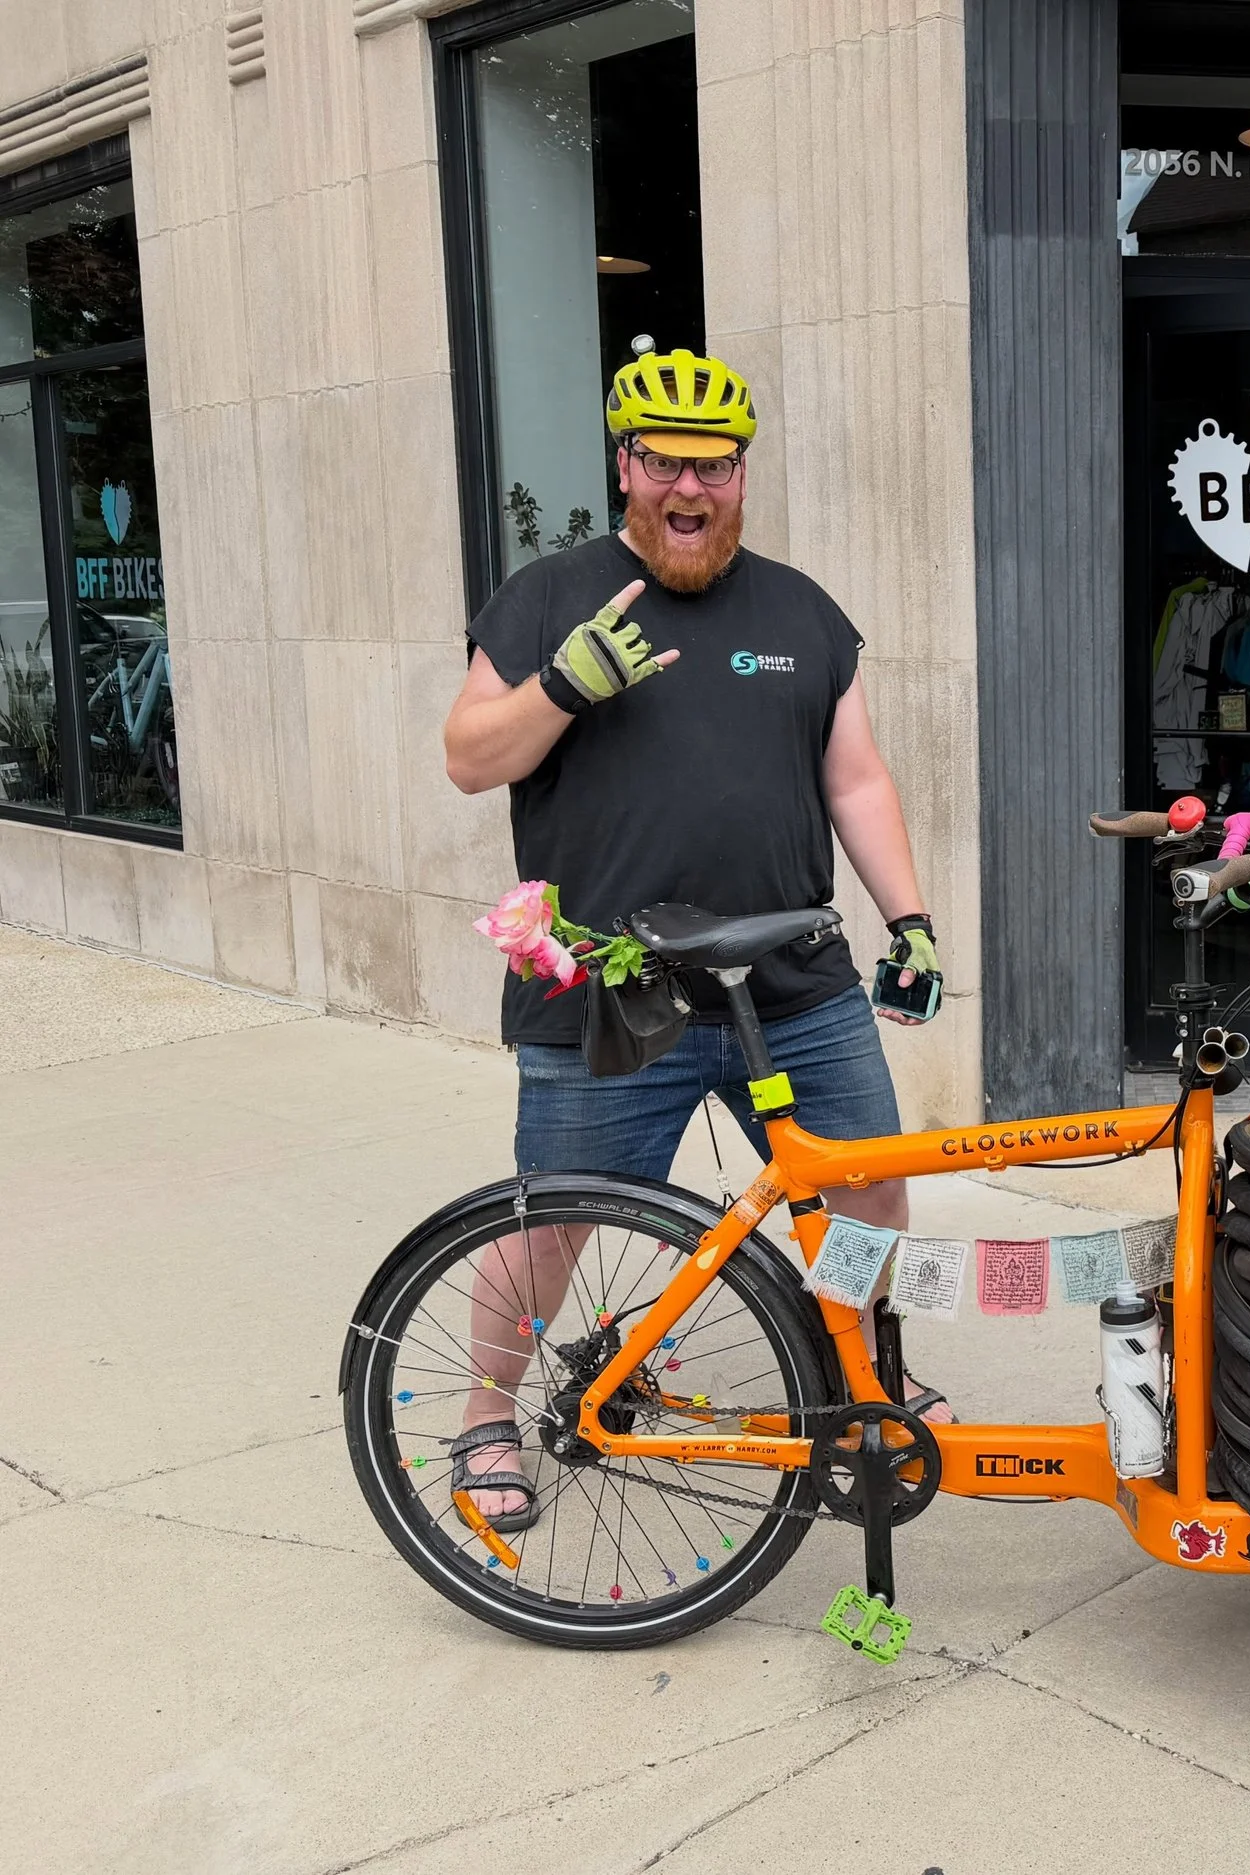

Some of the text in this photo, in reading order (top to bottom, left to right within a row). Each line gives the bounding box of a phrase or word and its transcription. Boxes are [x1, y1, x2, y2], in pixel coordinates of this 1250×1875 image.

[1125, 149, 1201, 177] 2056
[1209, 152, 1241, 178] N.
[75, 557, 108, 600] BFF
[757, 655, 795, 667] SHIFT
[759, 664, 795, 672] TRANSIT
[941, 1120, 1119, 1156] CLOCKWORK
[578, 1201, 640, 1216] SCHWALBE
[975, 1454, 1066, 1477] THICK
